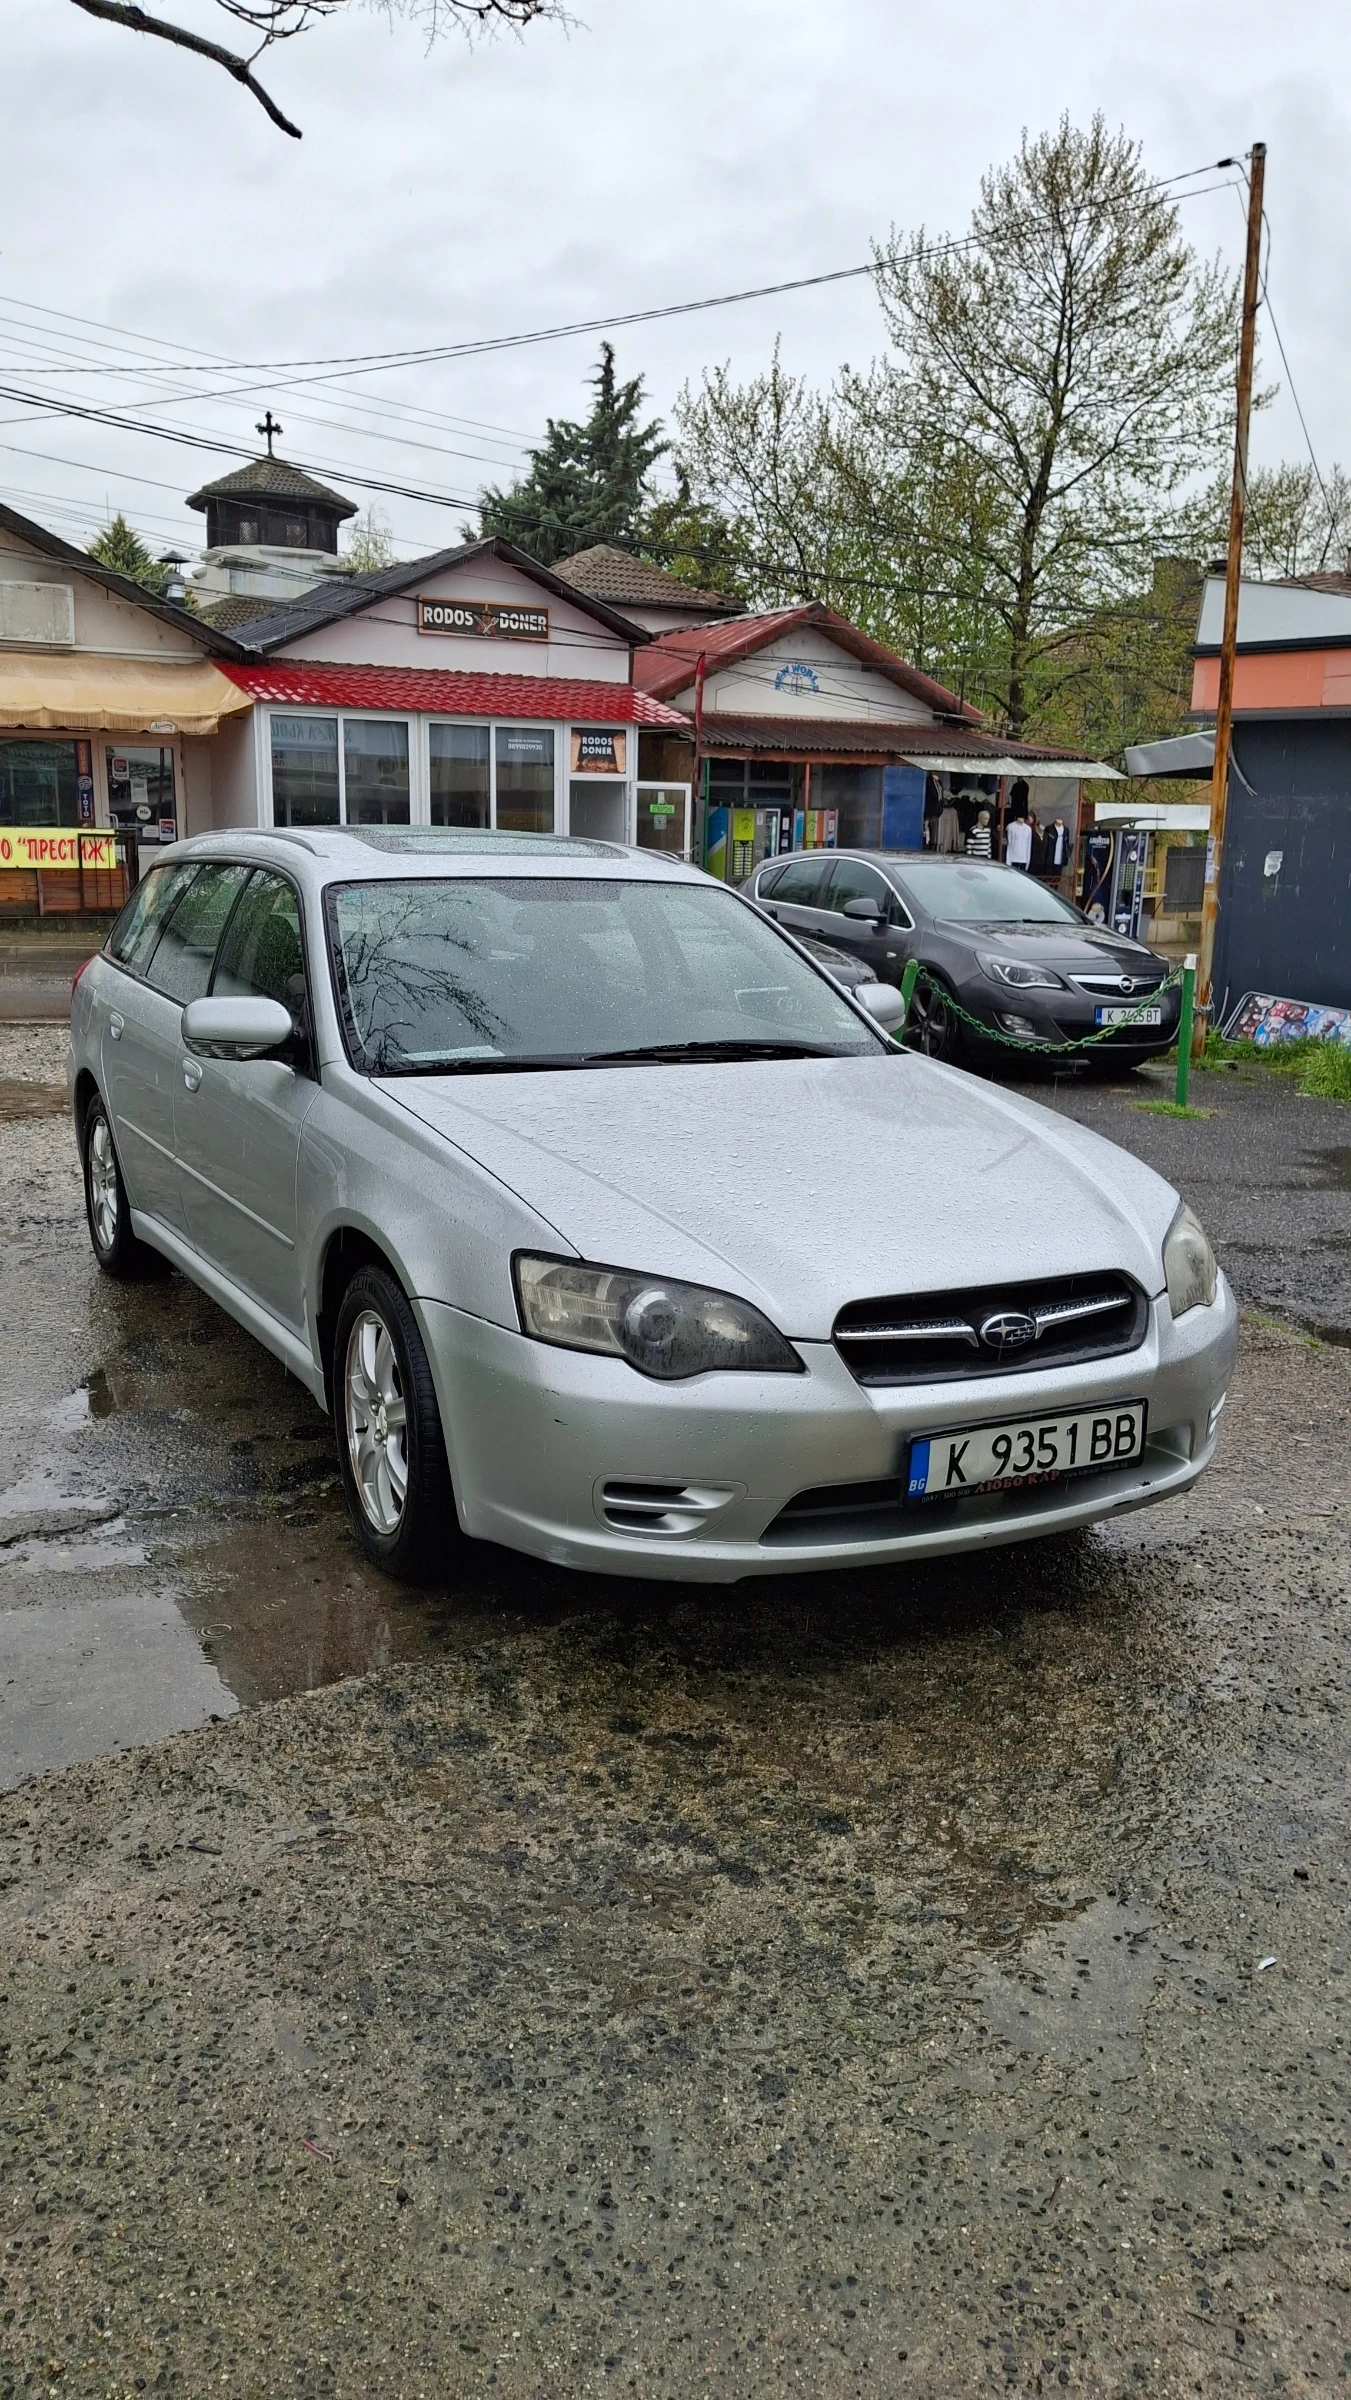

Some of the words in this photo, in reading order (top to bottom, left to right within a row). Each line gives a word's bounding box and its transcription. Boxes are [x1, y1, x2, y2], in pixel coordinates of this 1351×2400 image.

[423, 606, 474, 626] RODOS
[499, 612, 547, 632] DONER
[775, 665, 789, 690] NEW
[791, 664, 819, 693] WORLD
[582, 736, 613, 746] RODOS
[582, 746, 612, 755] DONER
[82, 793, 90, 817] ТОТО
[1107, 1010, 1114, 1023] K
[946, 1440, 970, 1486] K
[909, 1478, 926, 1491] BG
[974, 1475, 1023, 1494] ЛЮБО
[1028, 1470, 1060, 1485] КАР
